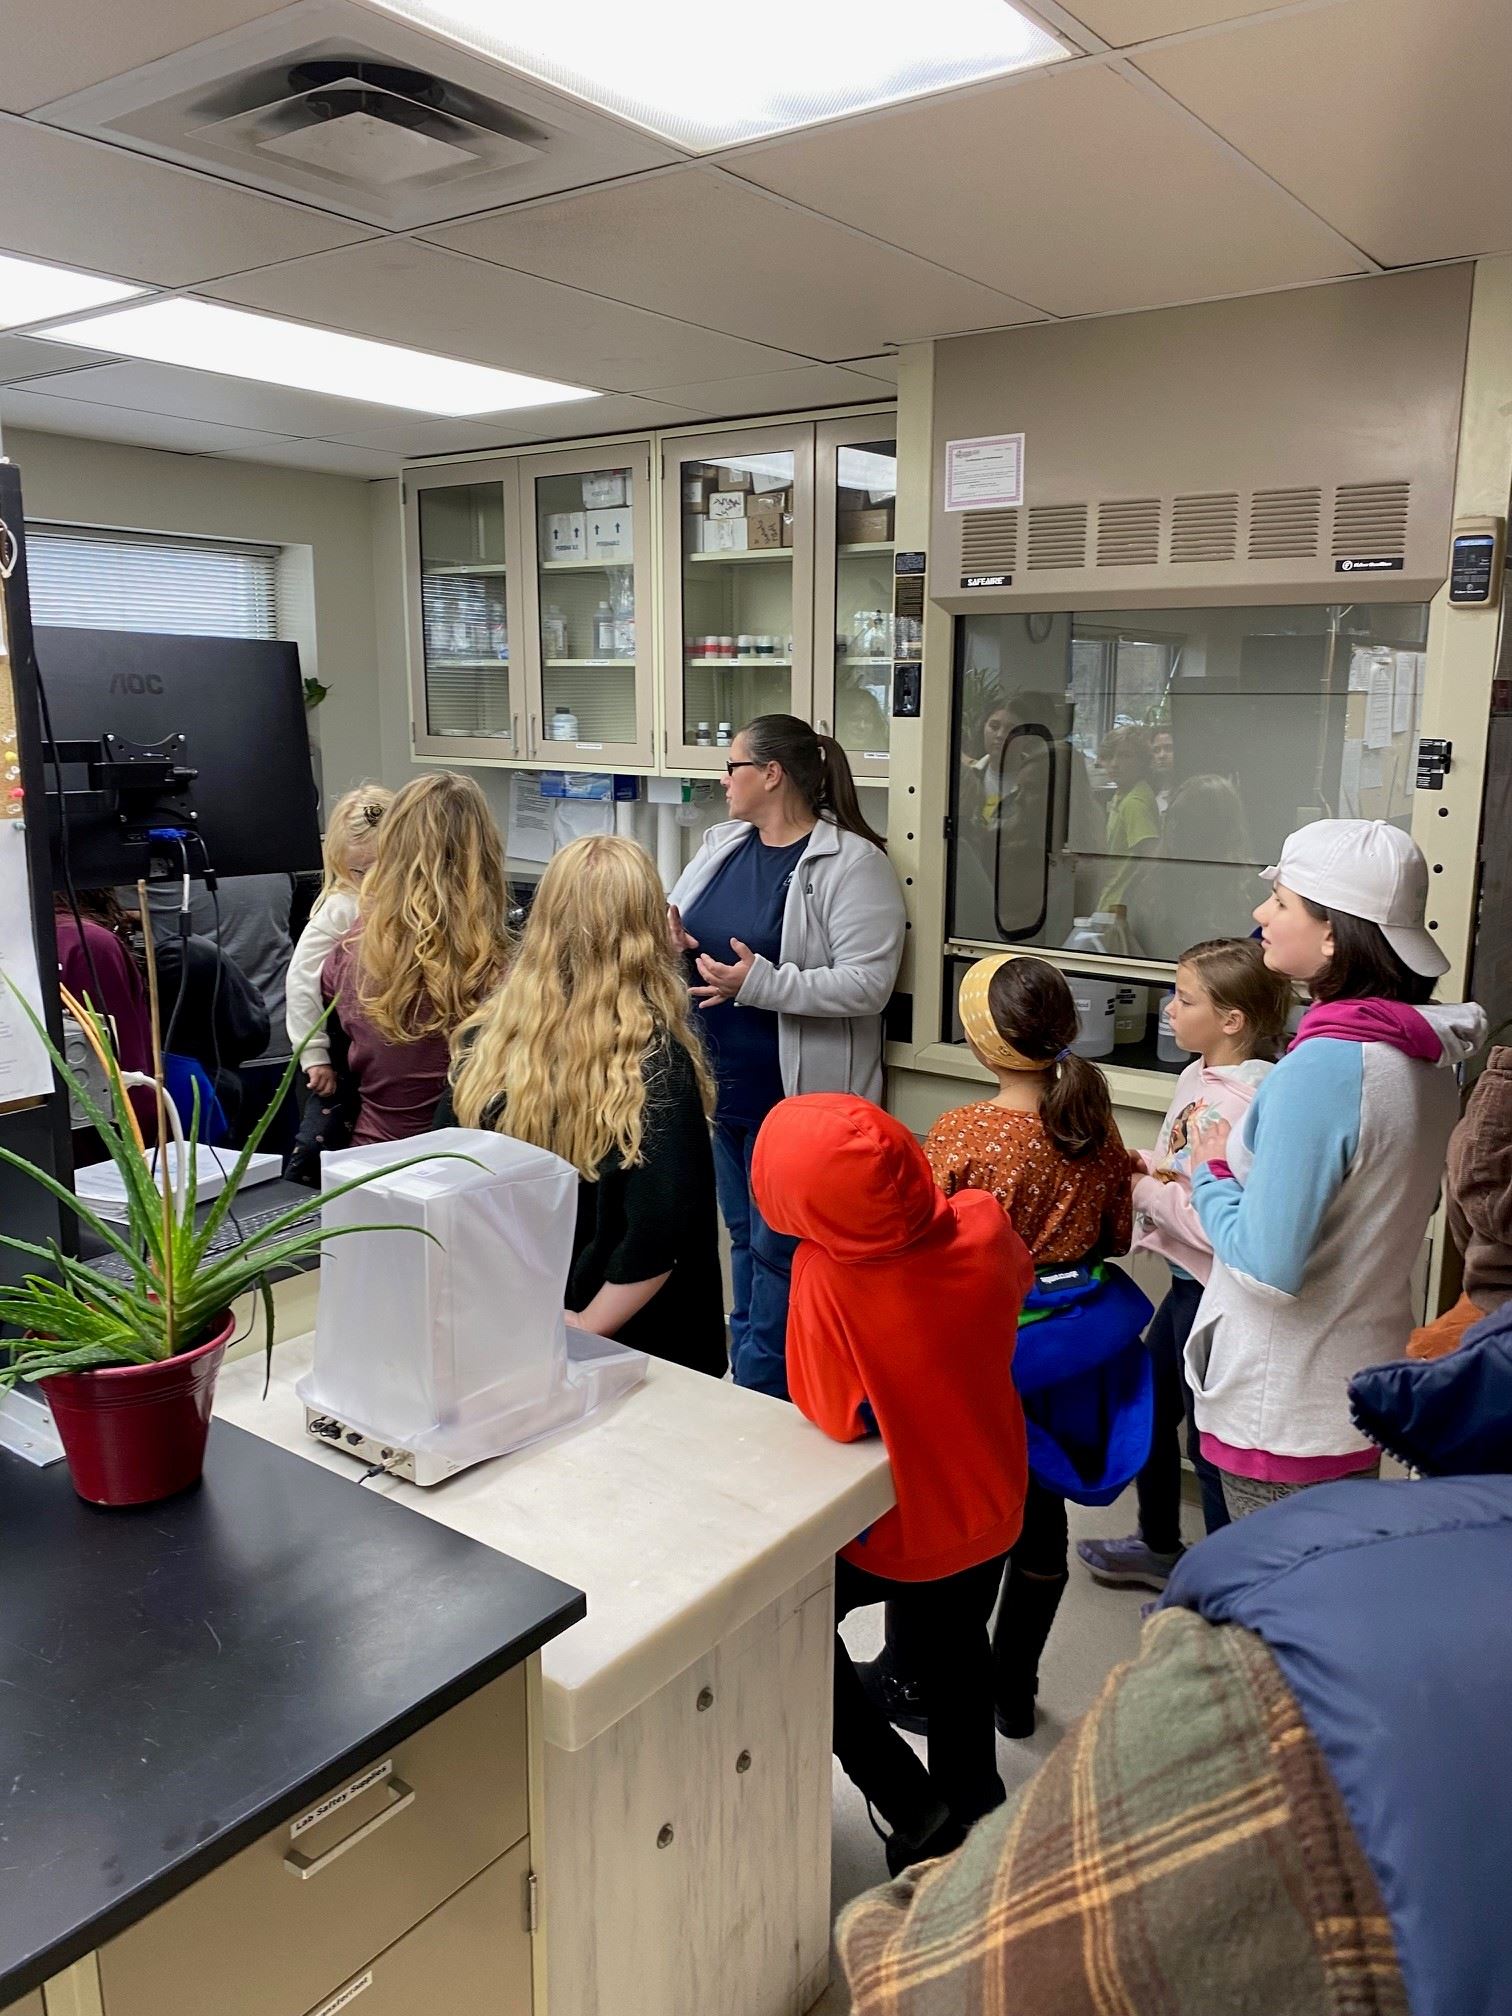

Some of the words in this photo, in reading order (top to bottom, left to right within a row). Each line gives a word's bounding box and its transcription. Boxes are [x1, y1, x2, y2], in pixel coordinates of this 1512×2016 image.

[110, 673, 164, 695] AOC
[296, 1815, 314, 1831] Lab
[316, 1792, 348, 1816] Saftey
[350, 1766, 387, 1793] Supplies
